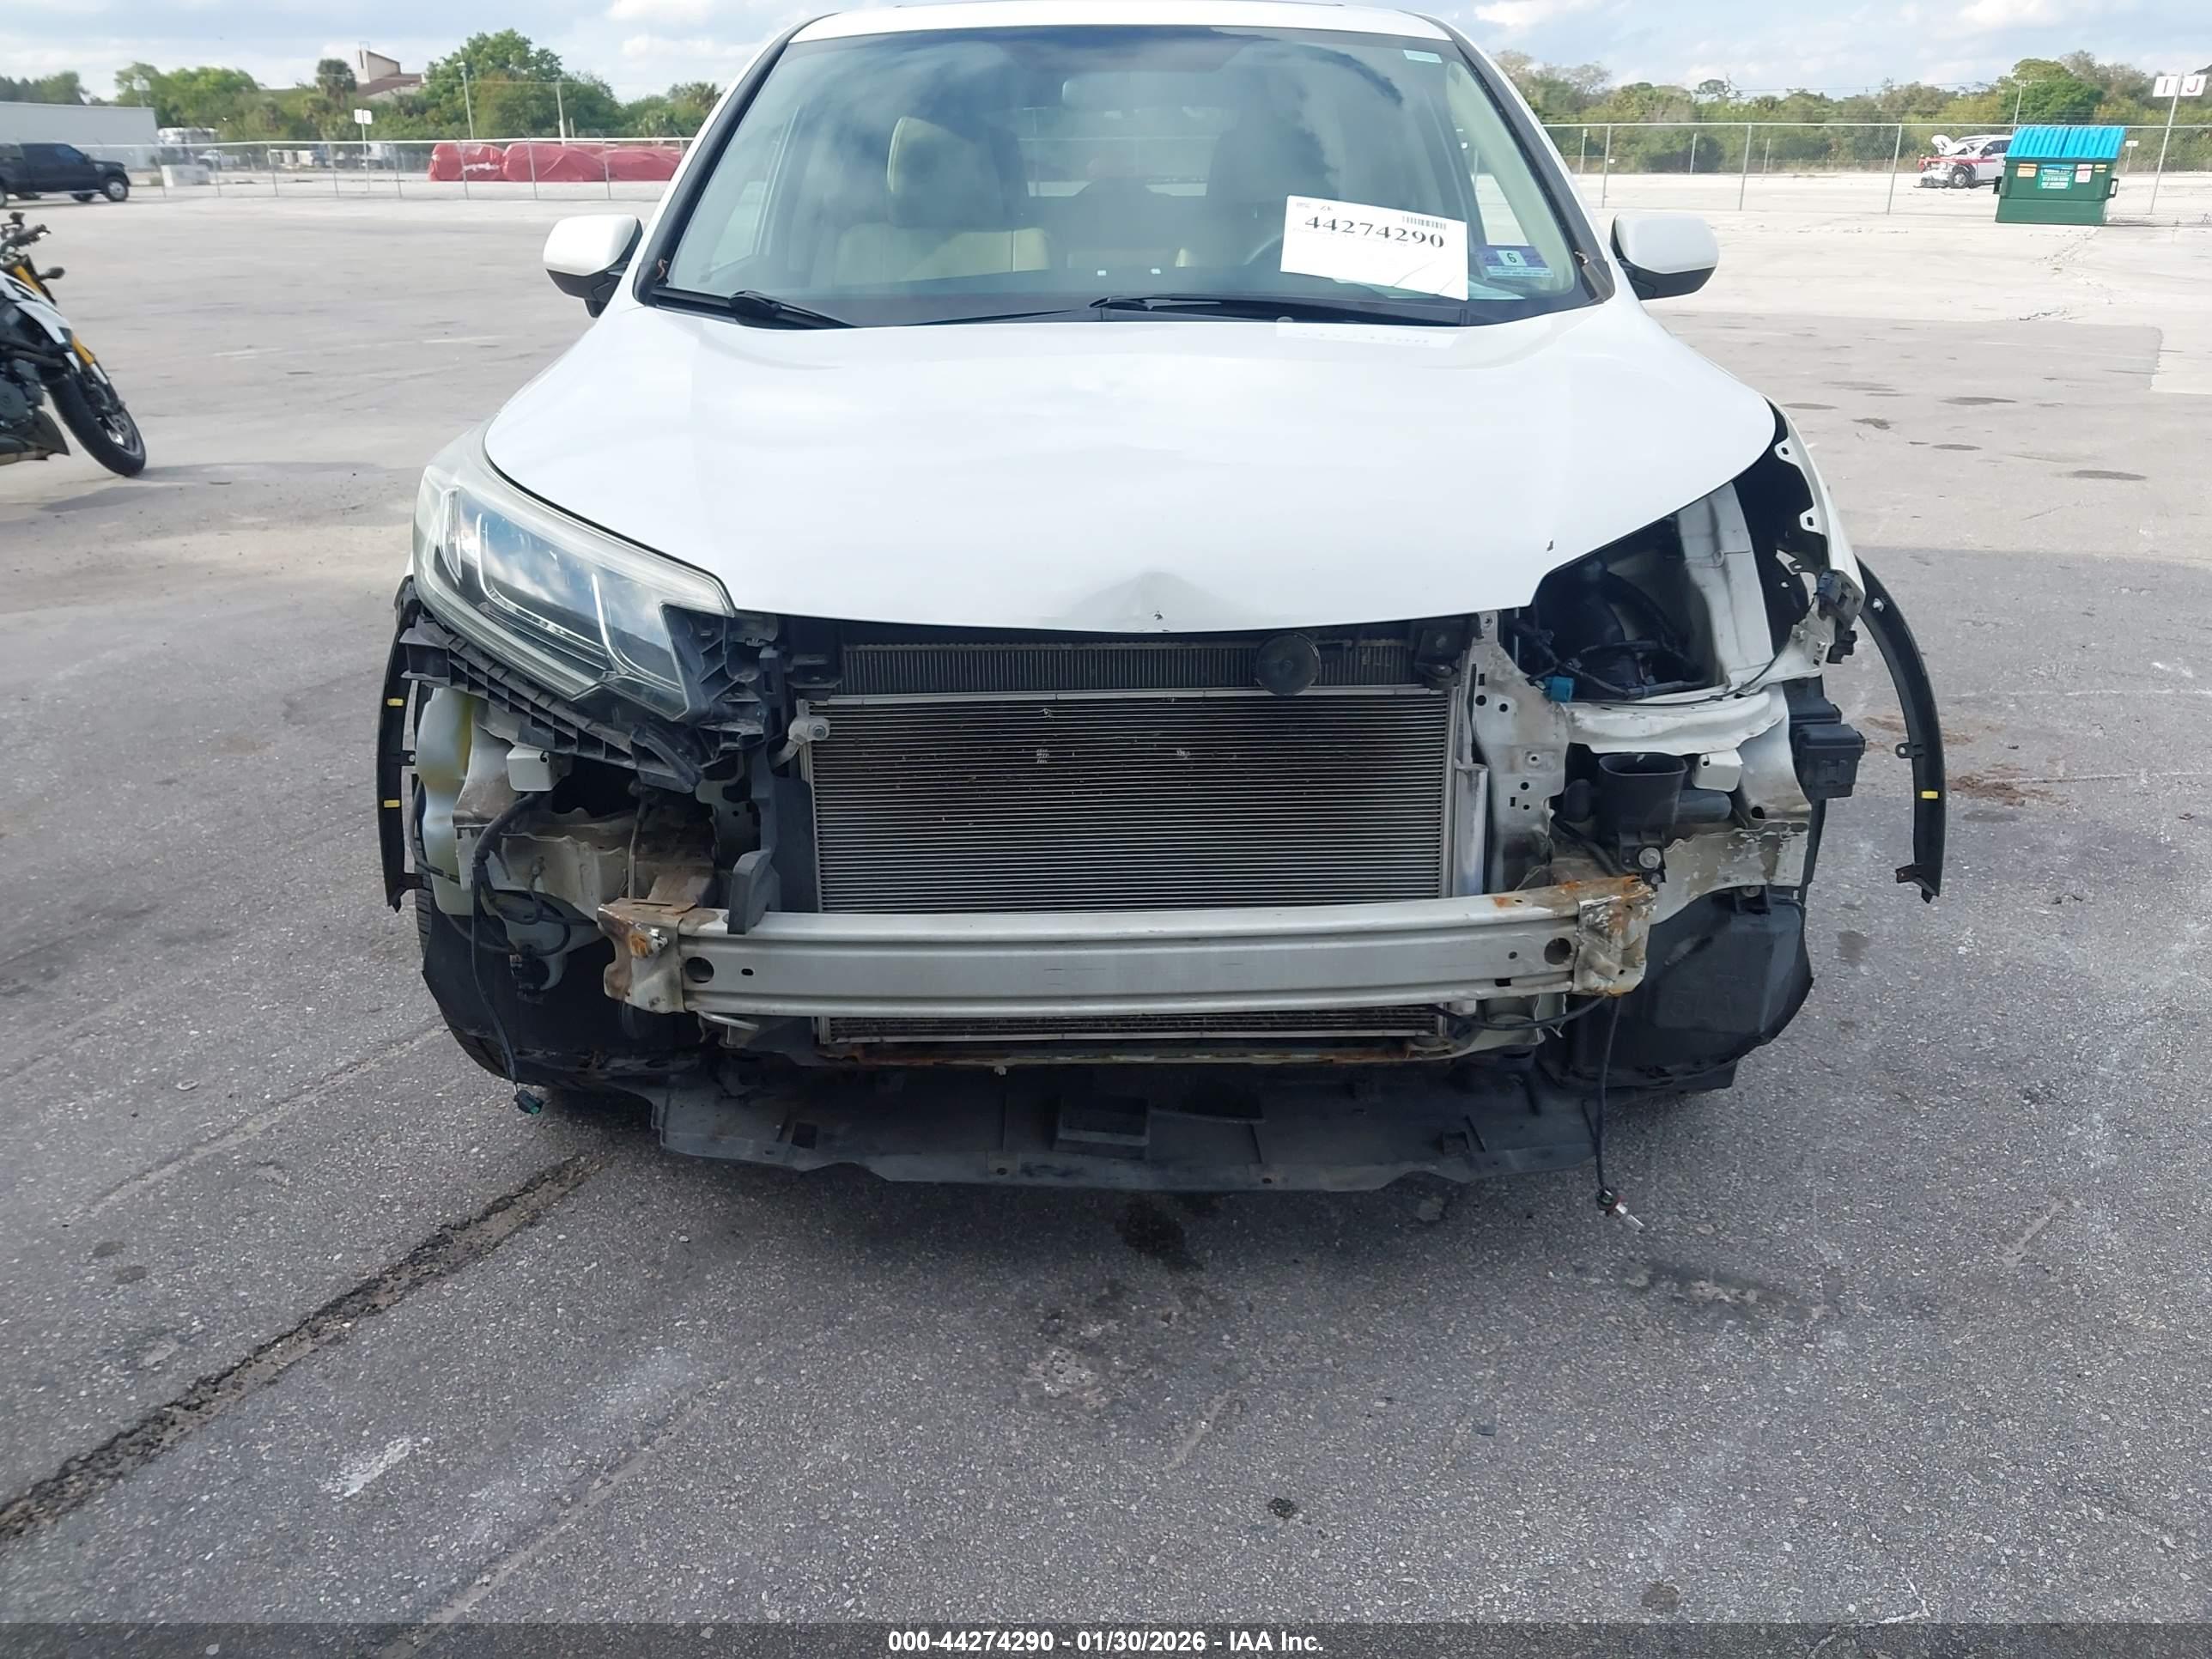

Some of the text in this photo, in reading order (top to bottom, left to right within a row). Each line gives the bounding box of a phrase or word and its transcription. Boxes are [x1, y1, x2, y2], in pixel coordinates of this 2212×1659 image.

[2186, 78, 2200, 94] J
[1304, 216, 1445, 248] 44274290
[1506, 252, 1517, 264] 6
